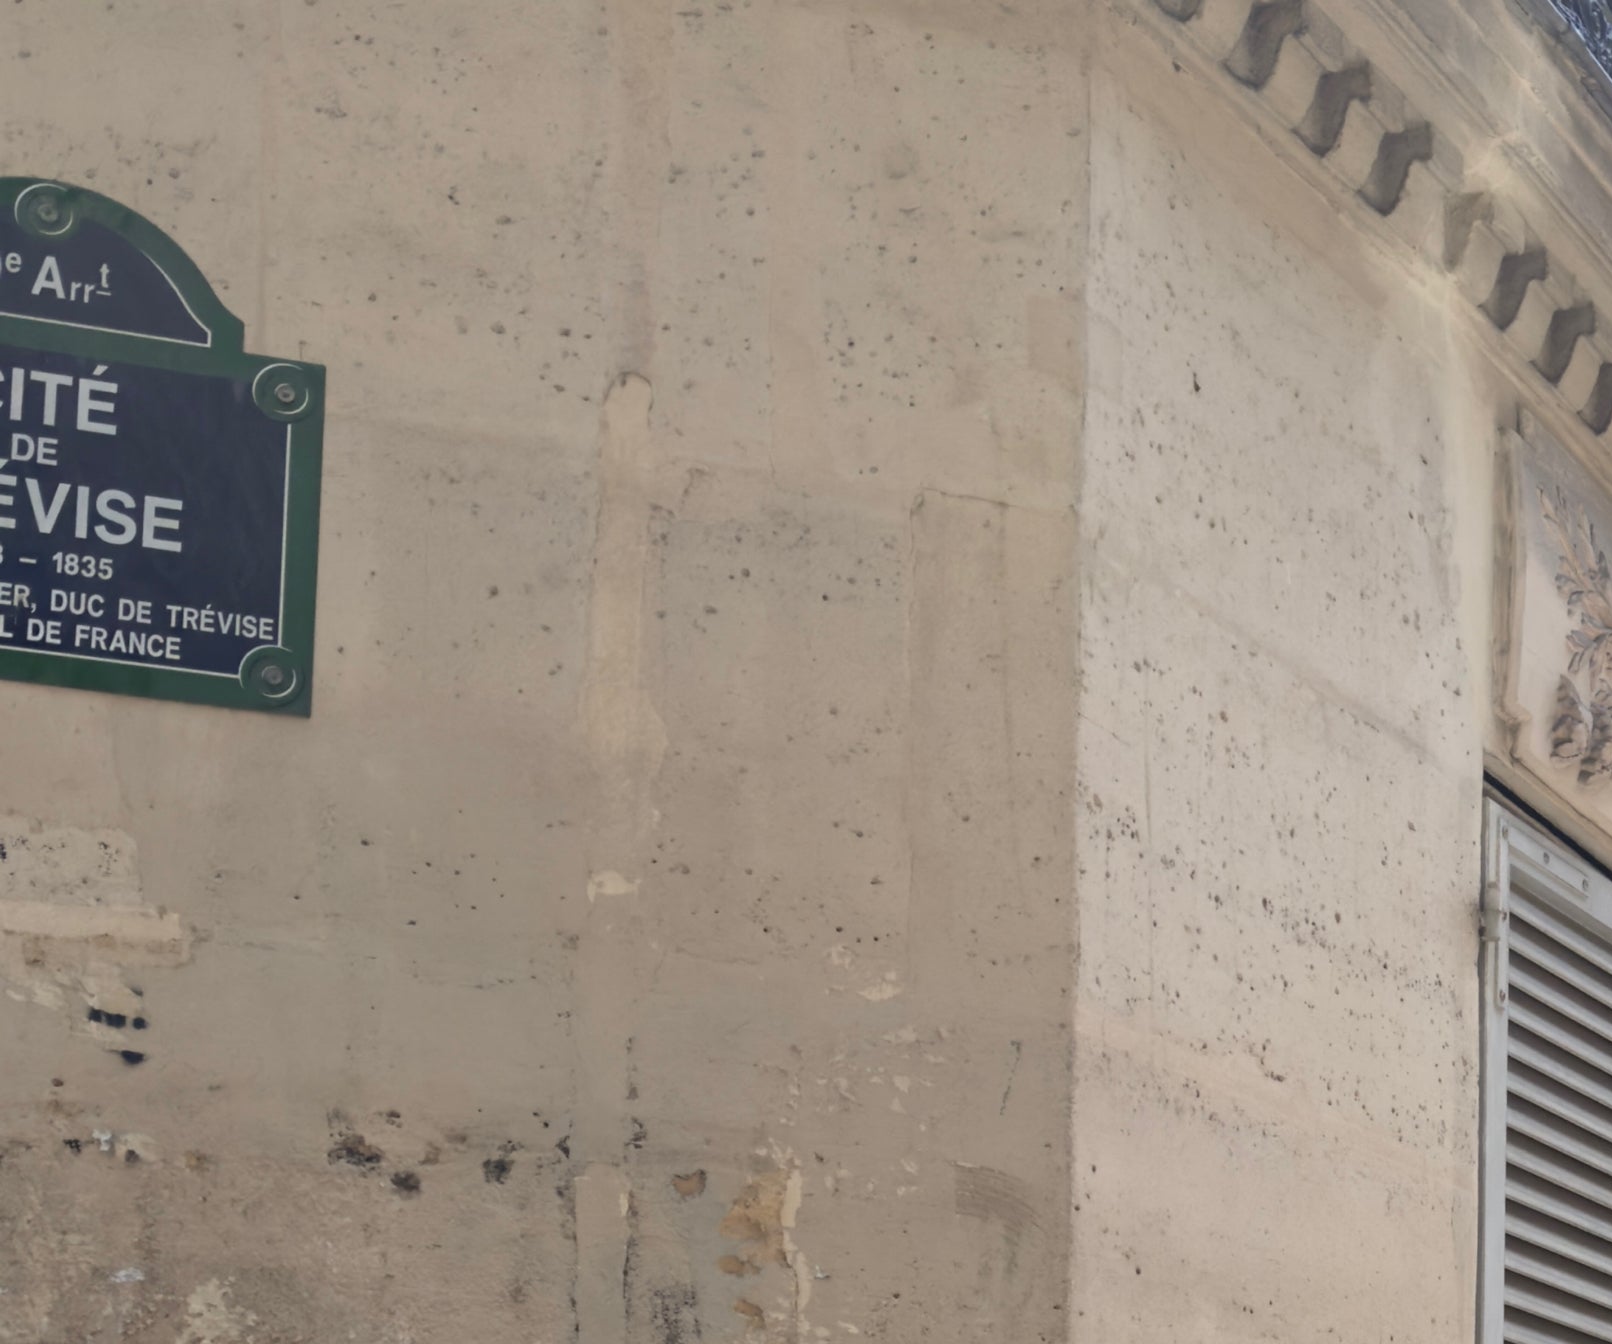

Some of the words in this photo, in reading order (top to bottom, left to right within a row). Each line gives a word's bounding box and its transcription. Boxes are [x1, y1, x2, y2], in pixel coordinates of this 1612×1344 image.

[10, 432, 59, 467] DE
[52, 551, 114, 580] 1835
[50, 588, 105, 618] DUC
[117, 597, 152, 624] DE
[166, 604, 275, 641] TRÉVISE
[26, 617, 62, 645] DE
[74, 623, 182, 660] FRANCE
